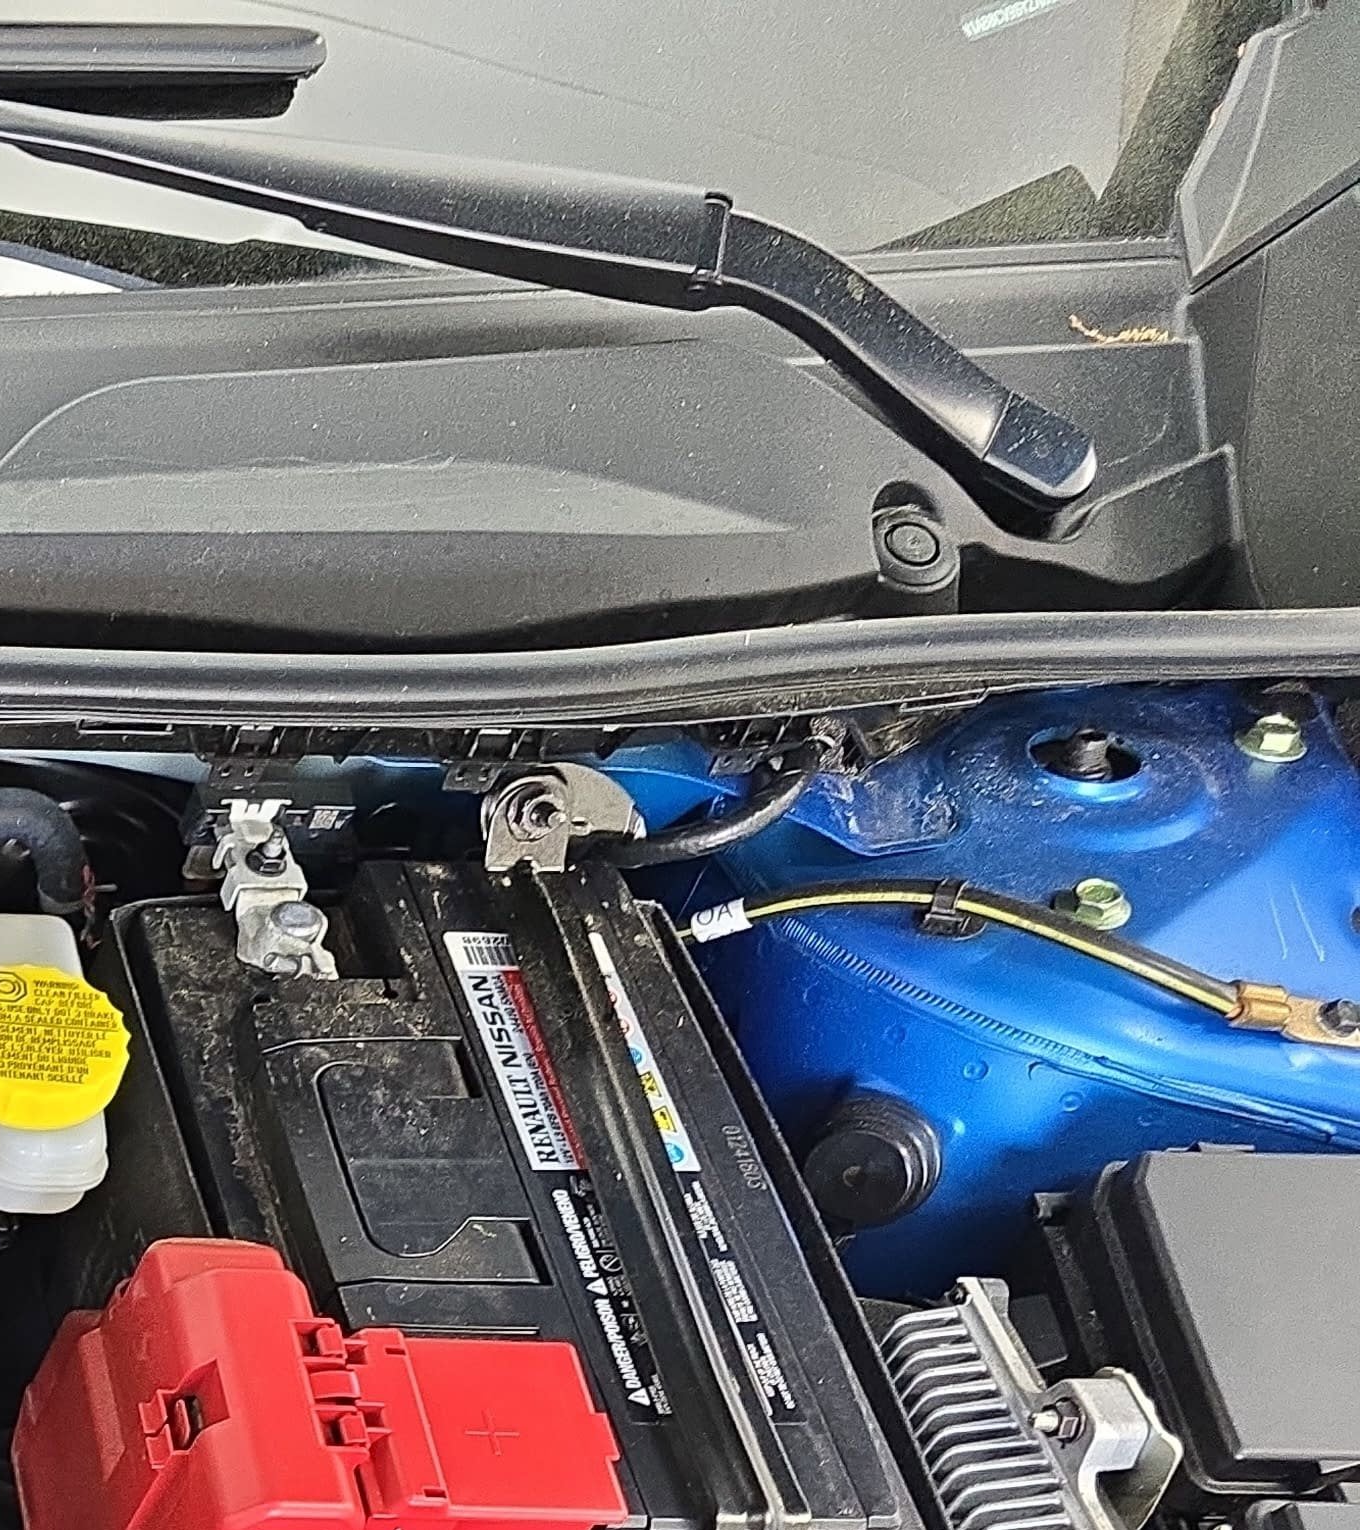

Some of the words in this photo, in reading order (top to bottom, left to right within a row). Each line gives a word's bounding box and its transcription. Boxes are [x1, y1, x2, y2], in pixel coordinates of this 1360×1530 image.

[468, 975, 523, 1068] NISSAN
[507, 1075, 560, 1163] RENAULT
[594, 1298, 642, 1389] DANGER/POISON
